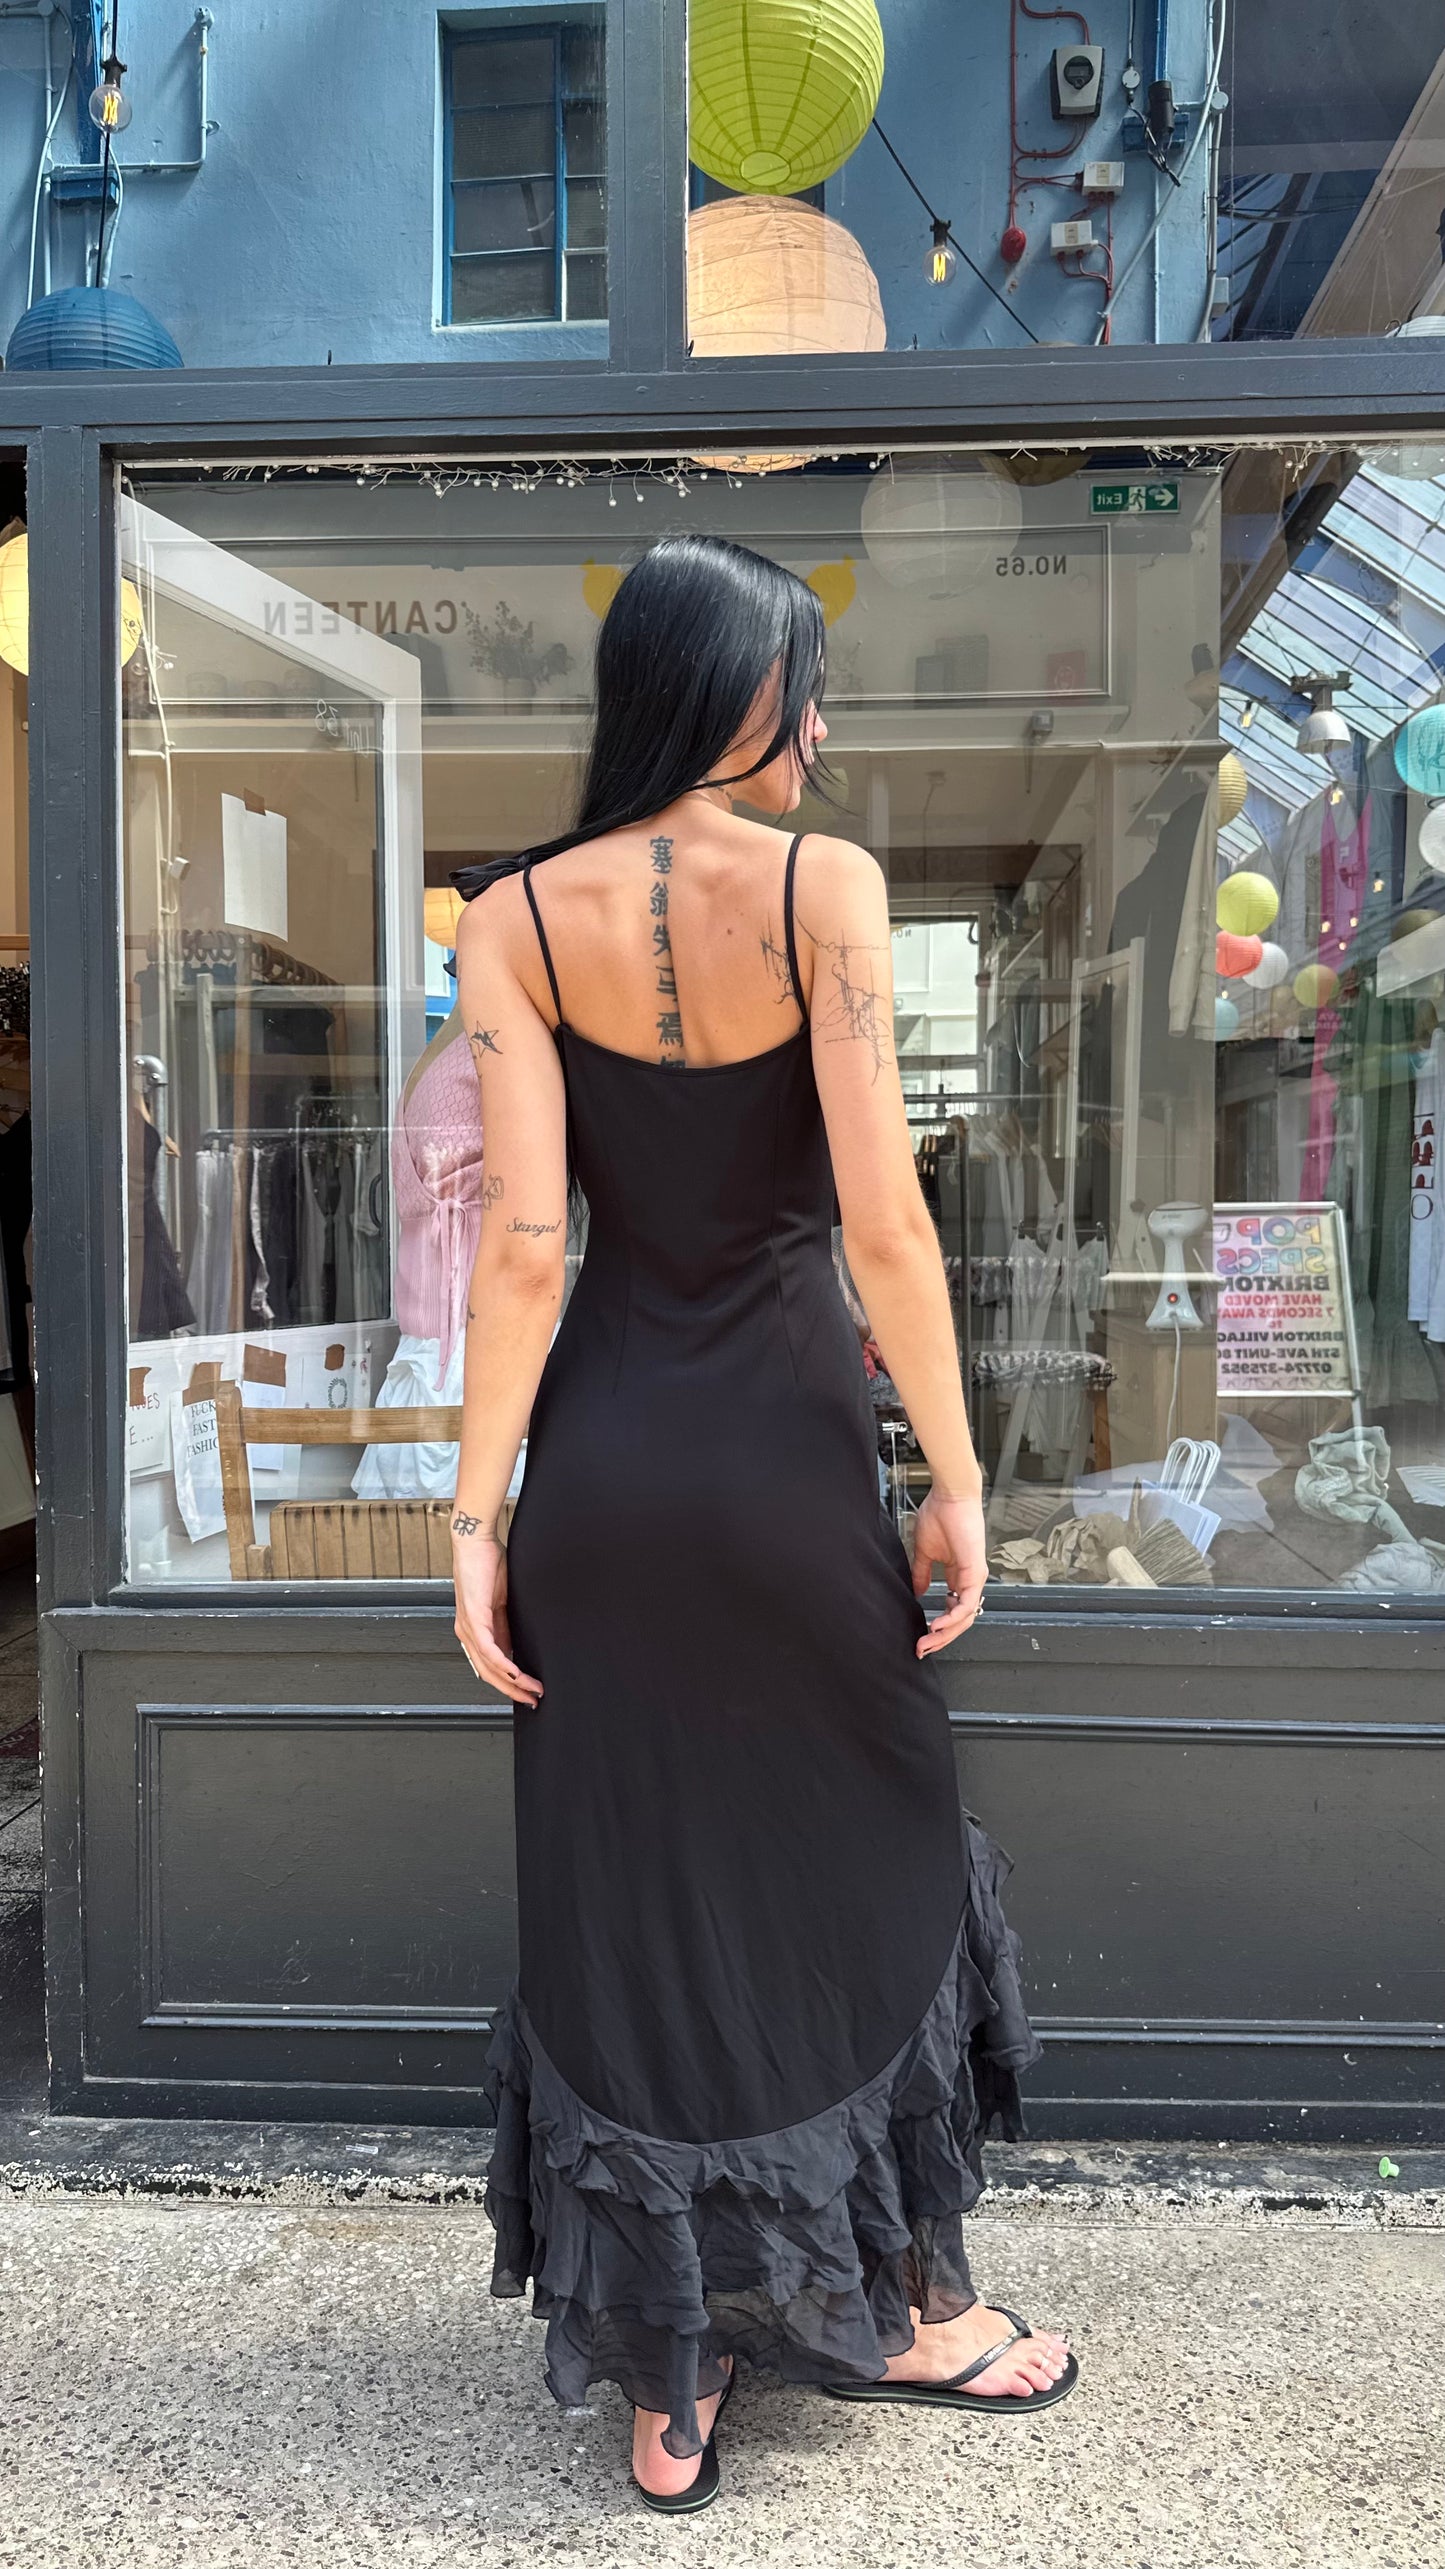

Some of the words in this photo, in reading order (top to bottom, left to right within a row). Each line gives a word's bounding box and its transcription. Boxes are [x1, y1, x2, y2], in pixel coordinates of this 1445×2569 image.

[506, 1217, 561, 1238] Stargirl
[191, 1400, 216, 1418] FUCK
[193, 1419, 216, 1436] FAST
